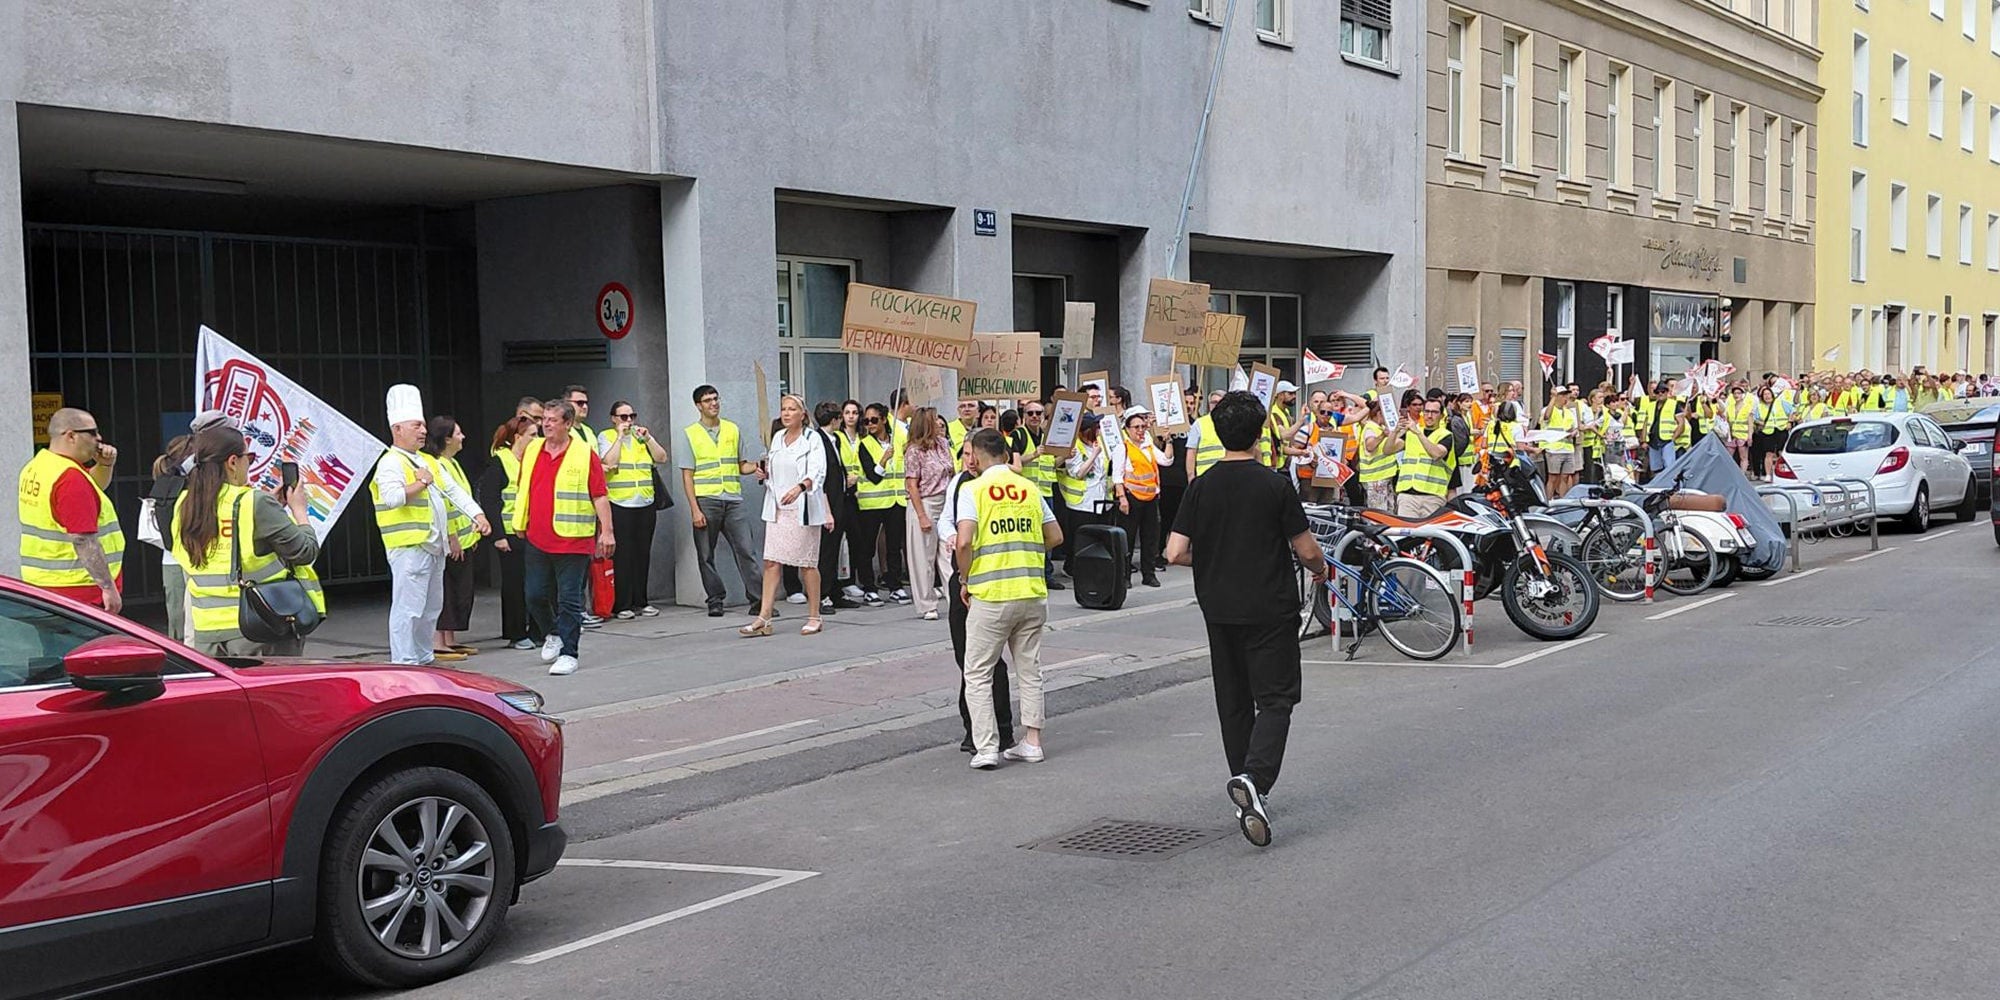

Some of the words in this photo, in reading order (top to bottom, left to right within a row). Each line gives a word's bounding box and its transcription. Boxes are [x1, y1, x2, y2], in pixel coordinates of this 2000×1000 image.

[977, 212, 994, 225] 9-11
[870, 289, 962, 323] RÜCKKEHR
[845, 327, 965, 362] VERHANDLUNGEN
[968, 338, 1024, 364] Arbeit
[958, 377, 1038, 397] ANERKENNUNG
[227, 383, 248, 427] SRAT
